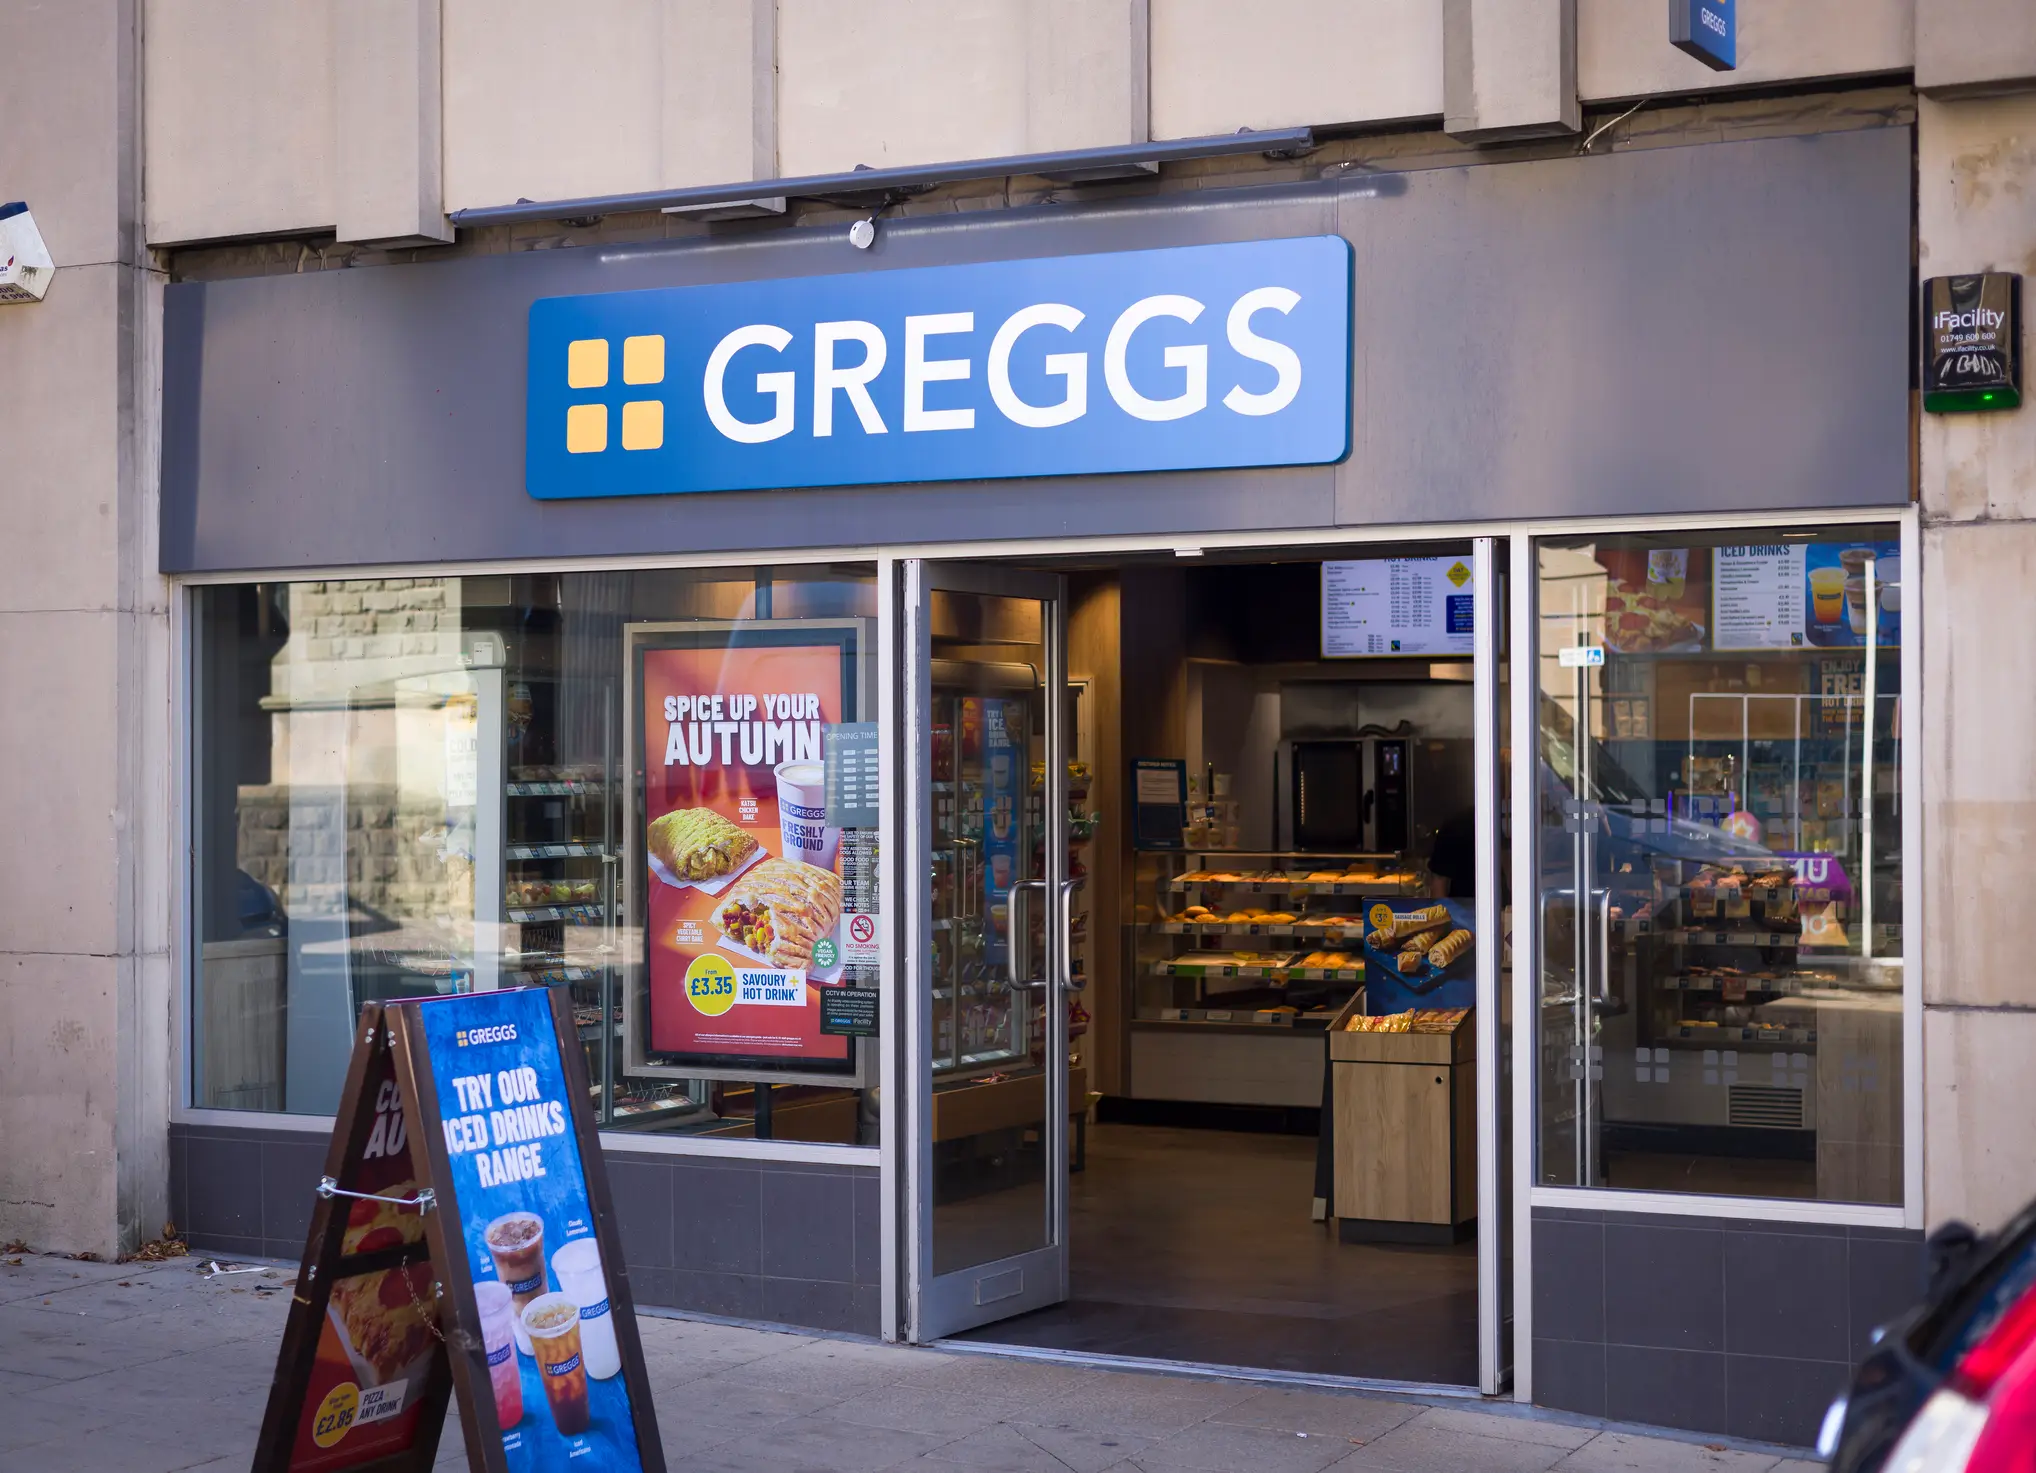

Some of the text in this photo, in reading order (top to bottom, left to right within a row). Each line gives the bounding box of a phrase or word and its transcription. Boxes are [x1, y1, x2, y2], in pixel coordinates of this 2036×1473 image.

[1701, 7, 1726, 37] GREGGS
[1934, 308, 2005, 330] iFacility
[1940, 333, 1964, 343] 01749
[1981, 331, 1996, 341] 600
[1940, 344, 1996, 354] www.ifacility.co.uk
[702, 286, 1302, 445] GREGGS
[1720, 545, 1790, 557] ICED DRINKS
[1821, 659, 1860, 673] ENJOY
[664, 693, 820, 721] SPICE UP YOUR
[988, 718, 1004, 730] ICE
[664, 720, 821, 766] AUTUMN
[826, 731, 878, 741] OPENING TIME
[790, 806, 825, 818] GREGGS
[782, 818, 825, 838] FRESHLY
[783, 830, 824, 851] GROUND
[691, 976, 733, 996] £3.35
[742, 973, 787, 987] SAVOURY
[743, 987, 762, 1000] HOT
[847, 990, 877, 998] OPERATION
[468, 1023, 518, 1045] GREGGS
[451, 1066, 541, 1113] TRY OUR
[442, 1100, 566, 1155] ICED DRINKS
[475, 1142, 547, 1188] RANGE
[566, 1226, 588, 1236] Lemonade
[514, 1276, 541, 1292] GREGGS
[581, 1300, 609, 1318] GREGGS
[489, 1346, 510, 1362] REGGS
[553, 1355, 580, 1374] GREGGS
[362, 1390, 384, 1406] PIZZA
[315, 1406, 355, 1437] £2.85
[358, 1405, 376, 1421] ANY
